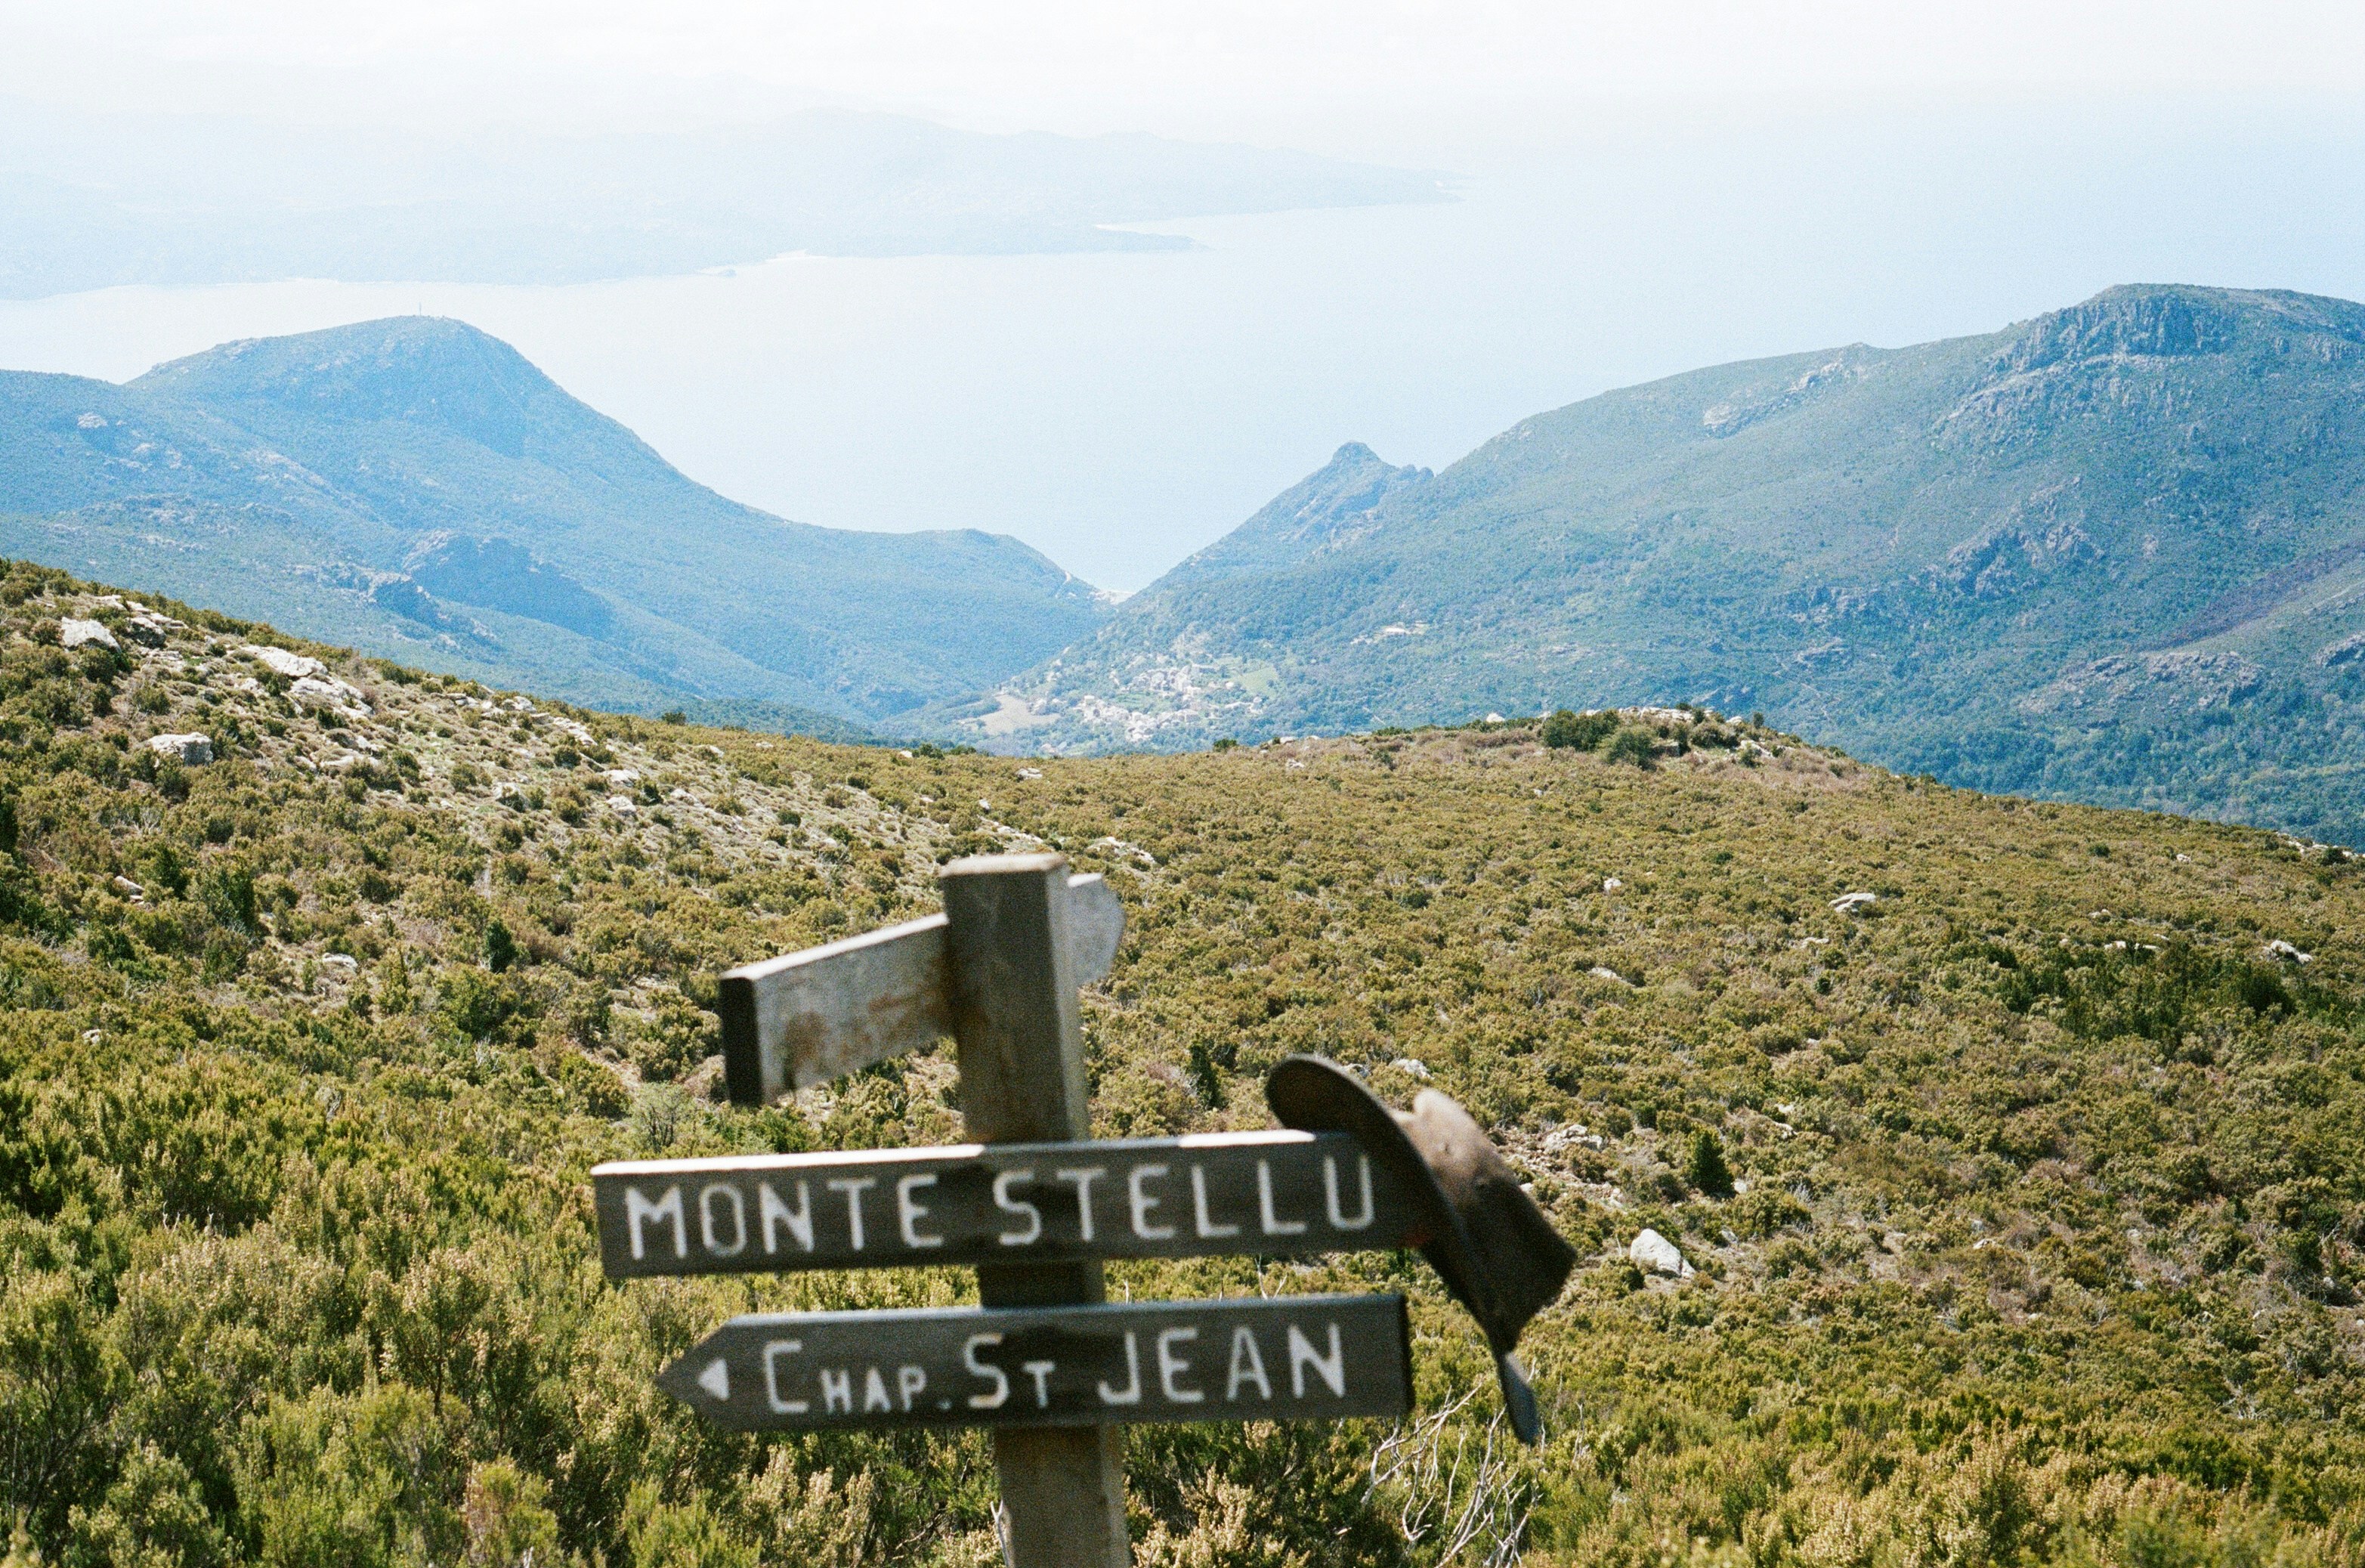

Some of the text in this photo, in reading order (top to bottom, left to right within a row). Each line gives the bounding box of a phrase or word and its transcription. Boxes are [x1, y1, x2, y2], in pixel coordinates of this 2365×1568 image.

[624, 1155, 1374, 1260] MONTE STELLU
[1098, 1322, 1345, 1406] JEAN
